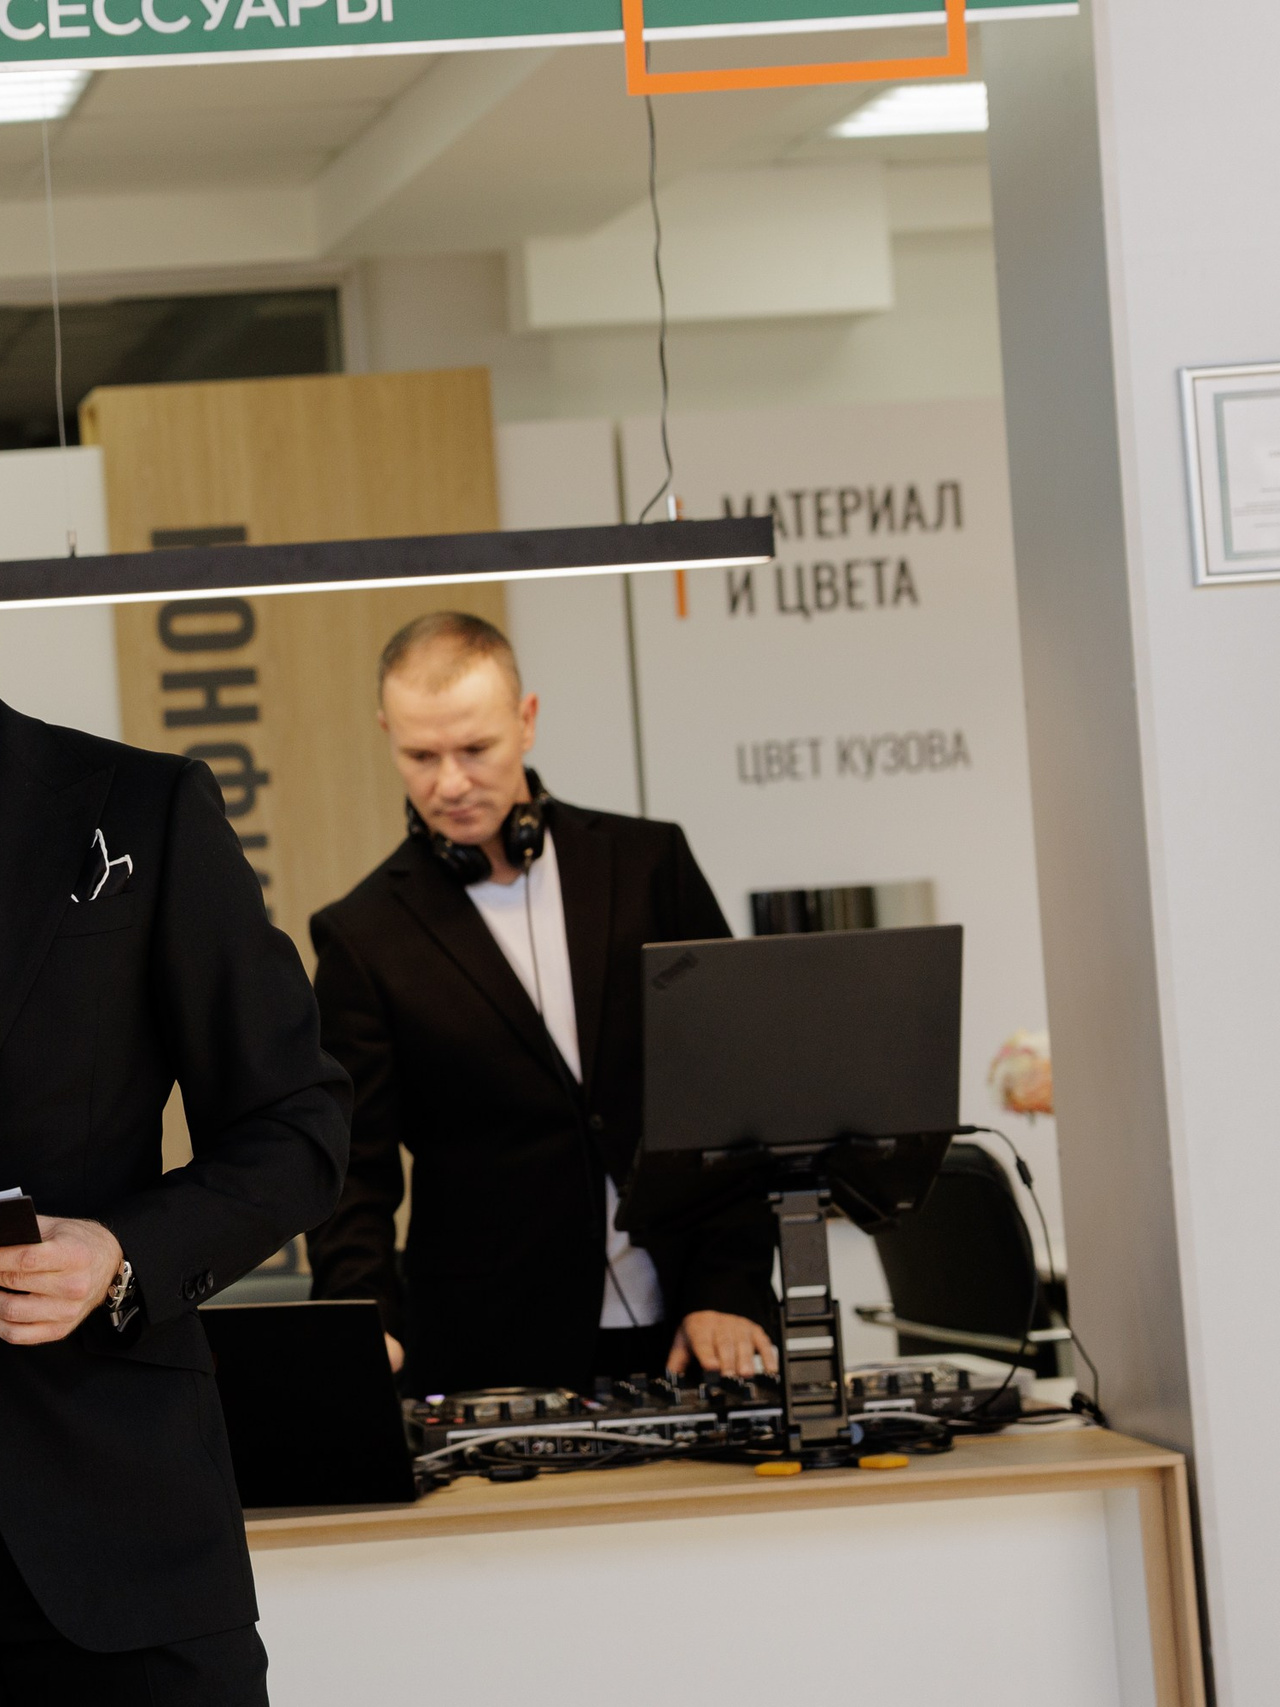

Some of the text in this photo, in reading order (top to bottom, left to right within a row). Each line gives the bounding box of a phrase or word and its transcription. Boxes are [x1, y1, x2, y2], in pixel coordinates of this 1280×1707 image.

[726, 556, 920, 622] И ЦВЕТА
[735, 728, 972, 786] ЦВЕТ КУЗОВА
